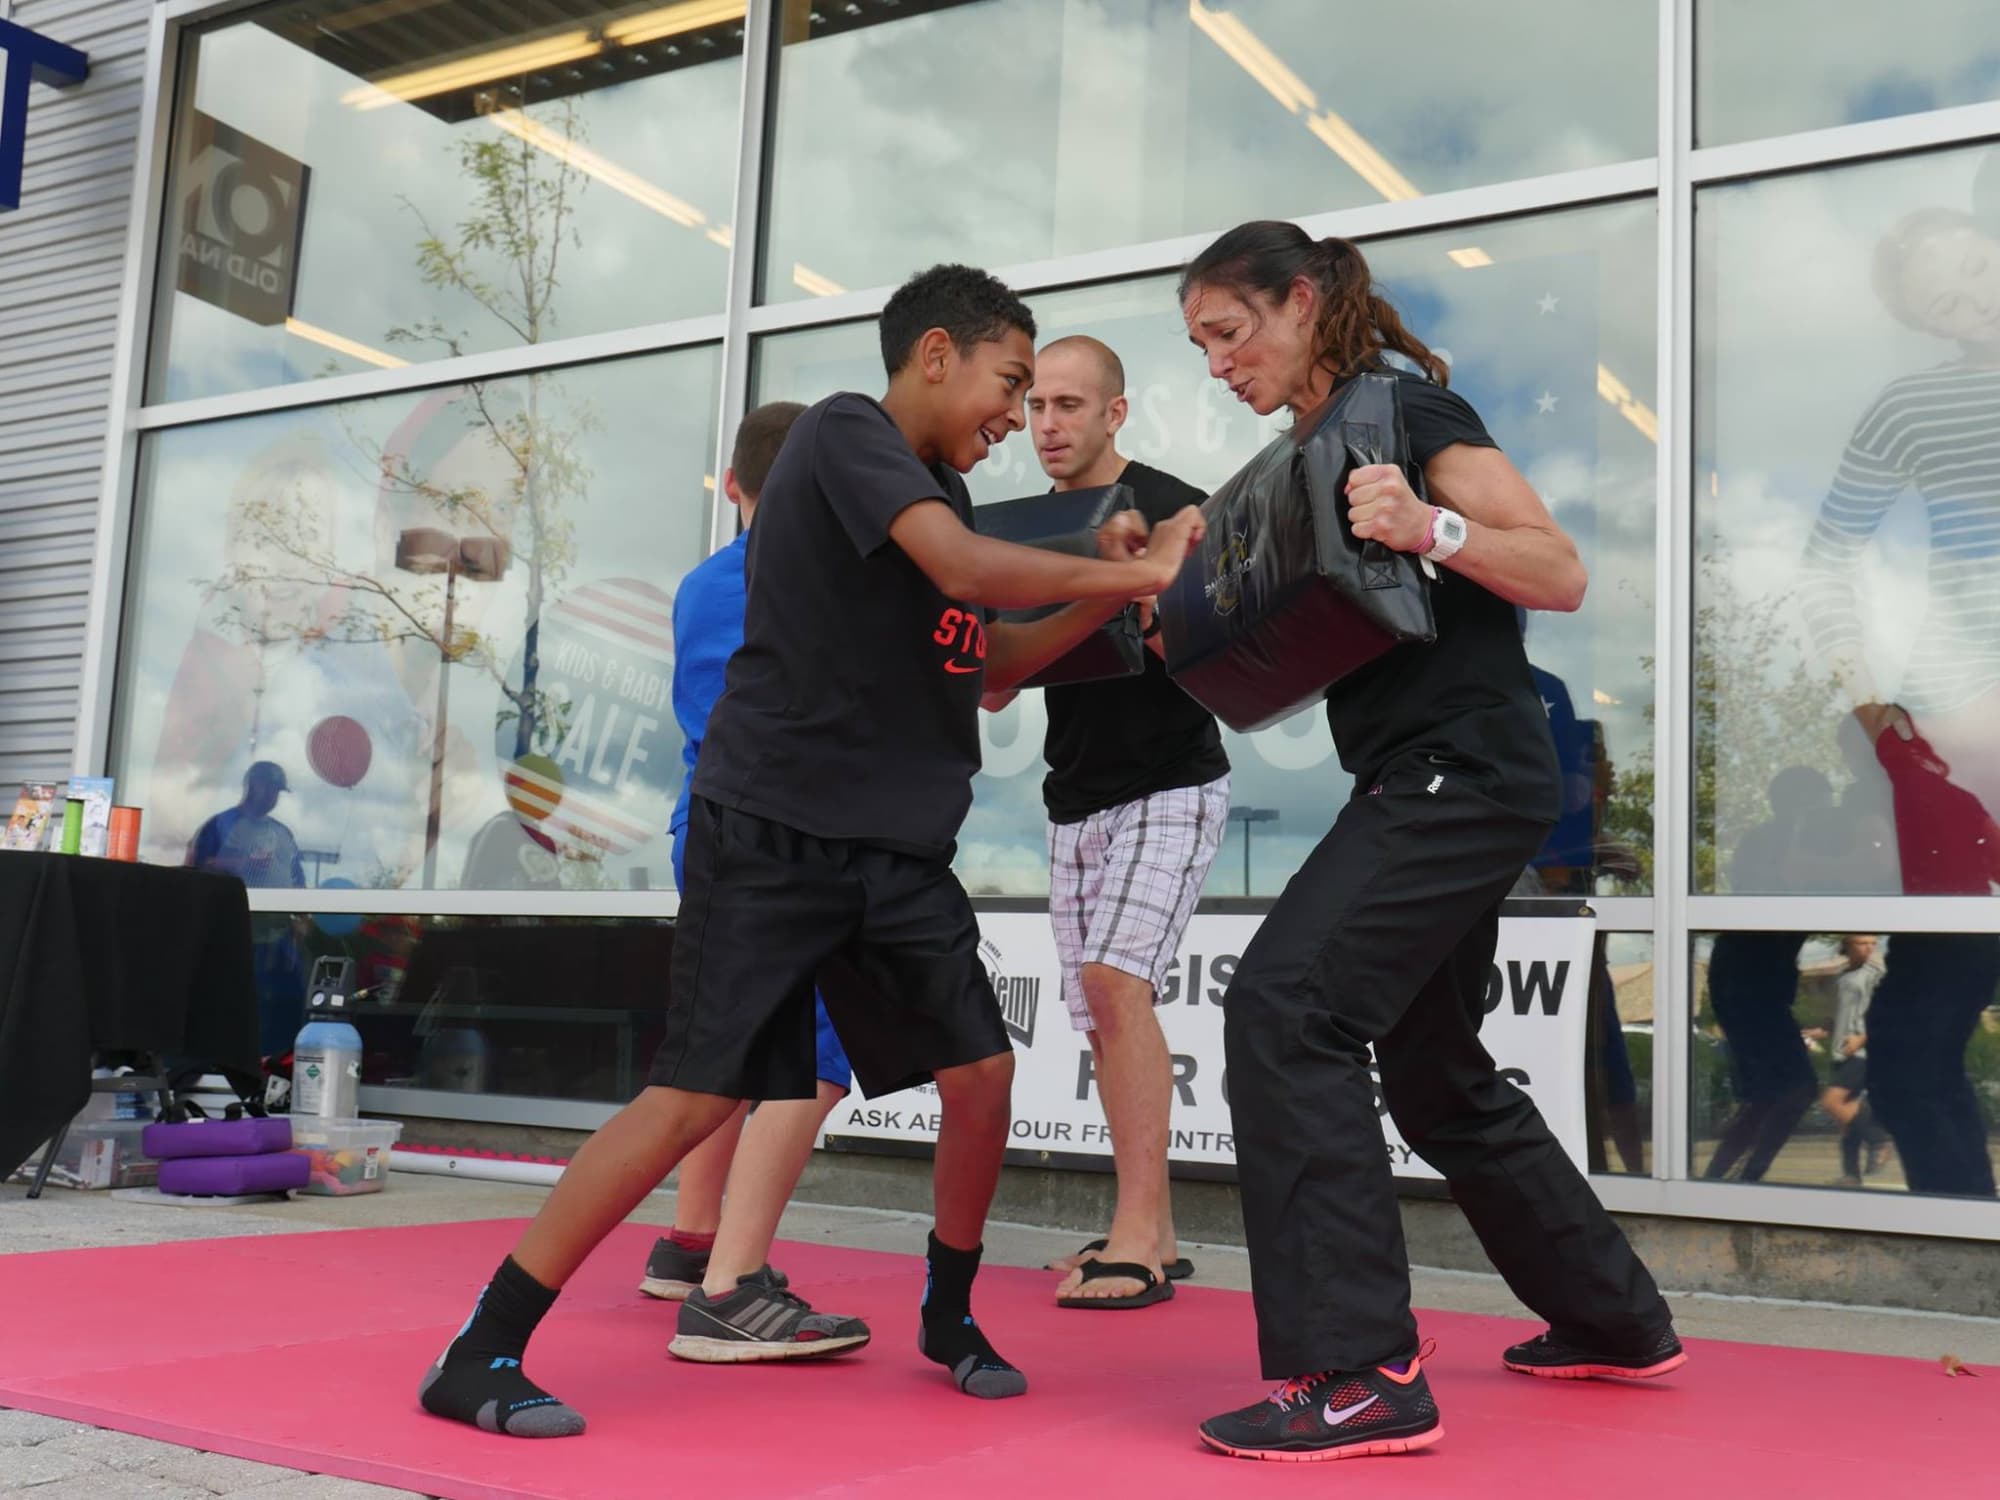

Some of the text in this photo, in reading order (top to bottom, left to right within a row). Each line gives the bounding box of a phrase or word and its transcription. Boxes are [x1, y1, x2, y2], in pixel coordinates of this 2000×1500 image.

[555, 640, 601, 684] KIDS
[619, 664, 674, 713] BABY
[530, 681, 659, 797] SALE
[1075, 1050, 1198, 1107] FR
[848, 1108, 902, 1129] ASK
[1012, 1120, 1072, 1140] OUR
